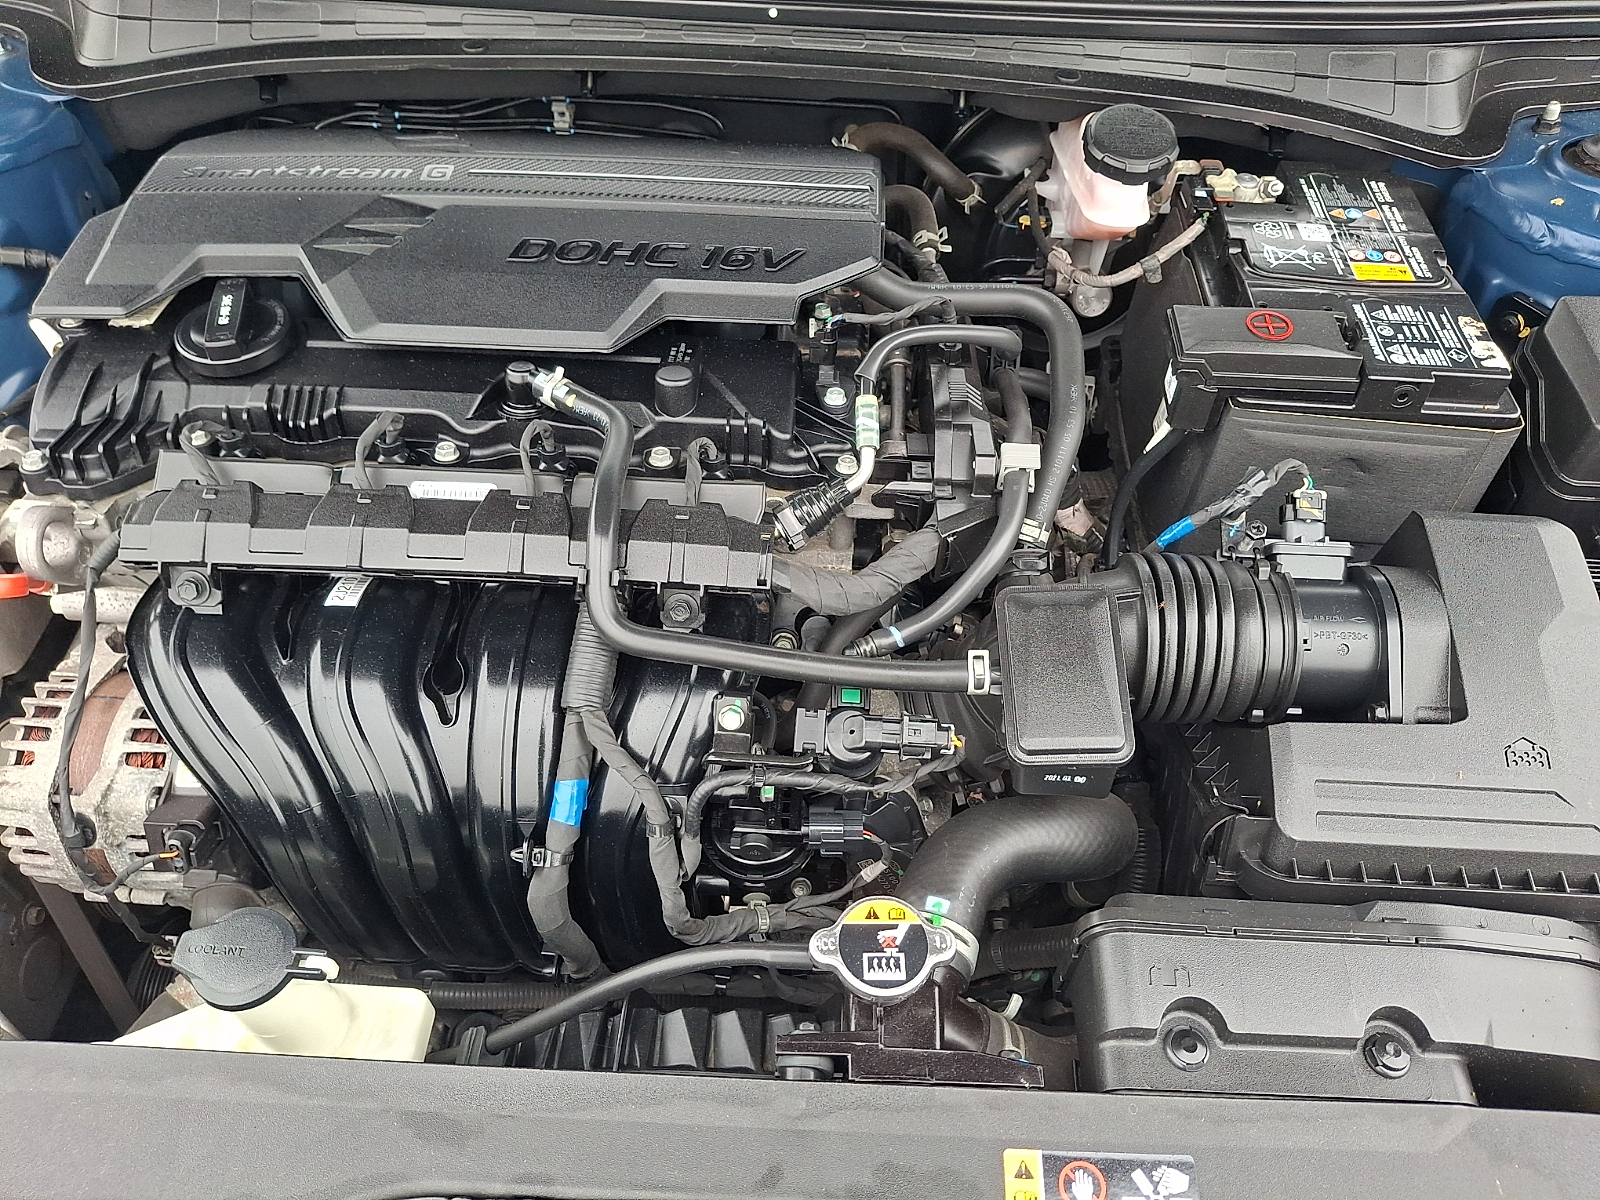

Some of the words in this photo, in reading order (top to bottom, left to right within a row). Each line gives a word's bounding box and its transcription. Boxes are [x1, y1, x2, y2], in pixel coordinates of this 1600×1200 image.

[174, 165, 413, 180] Smartstream
[422, 165, 452, 181] G
[506, 236, 692, 268] DOHC
[700, 244, 807, 272] 16V
[331, 577, 358, 601] 2J210
[187, 944, 247, 957] COOLANT
[814, 938, 836, 951] HCC
